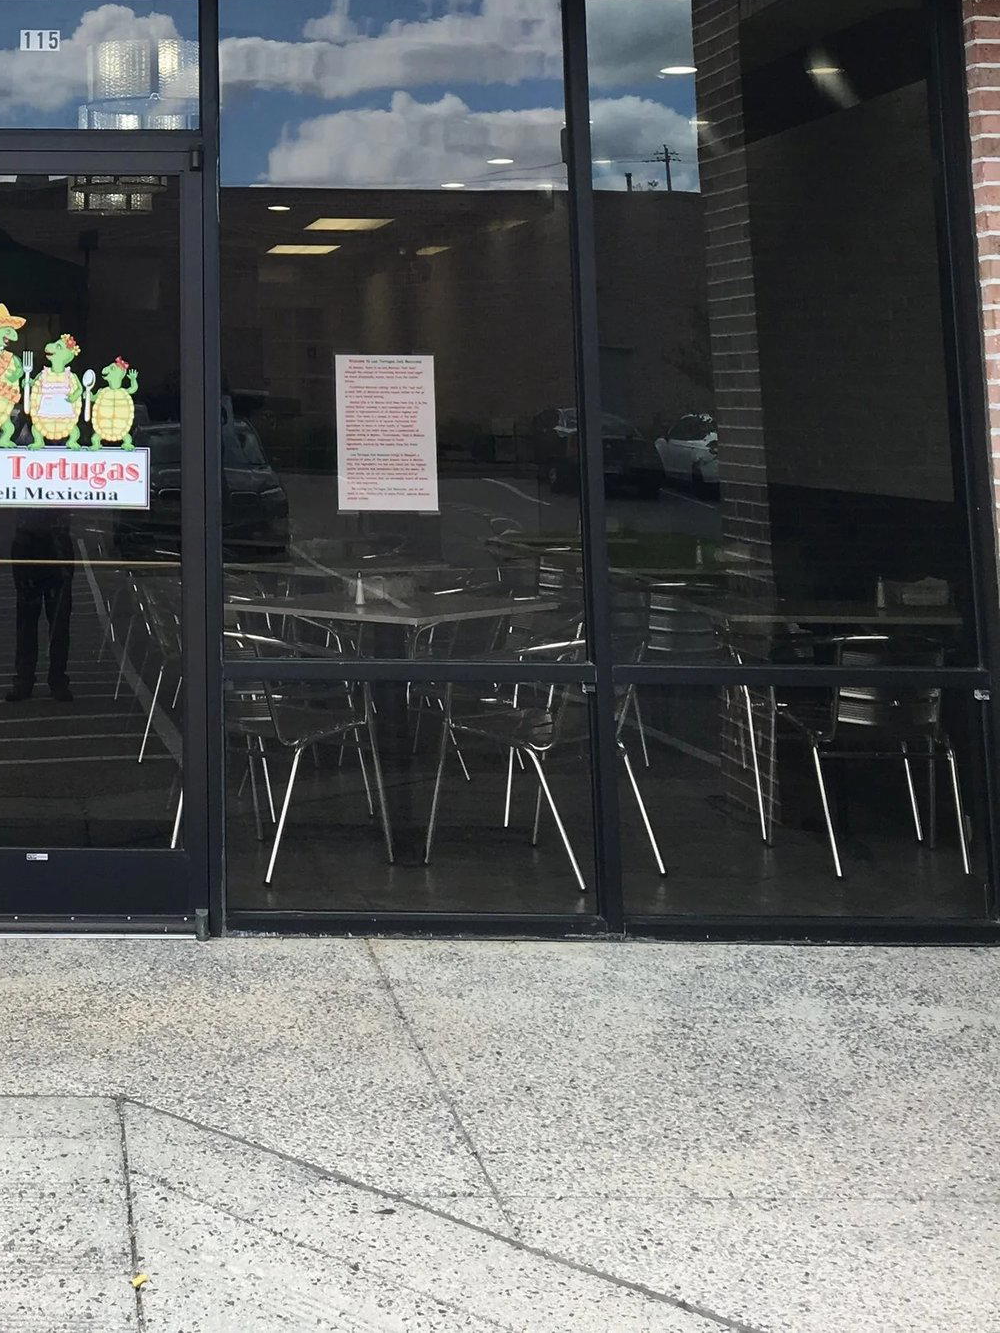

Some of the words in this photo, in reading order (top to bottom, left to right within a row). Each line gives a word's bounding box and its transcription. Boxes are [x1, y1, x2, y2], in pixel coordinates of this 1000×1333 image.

[24, 31, 58, 49] 115
[7, 455, 139, 489] Tortugas
[25, 486, 118, 501] Mexicana
